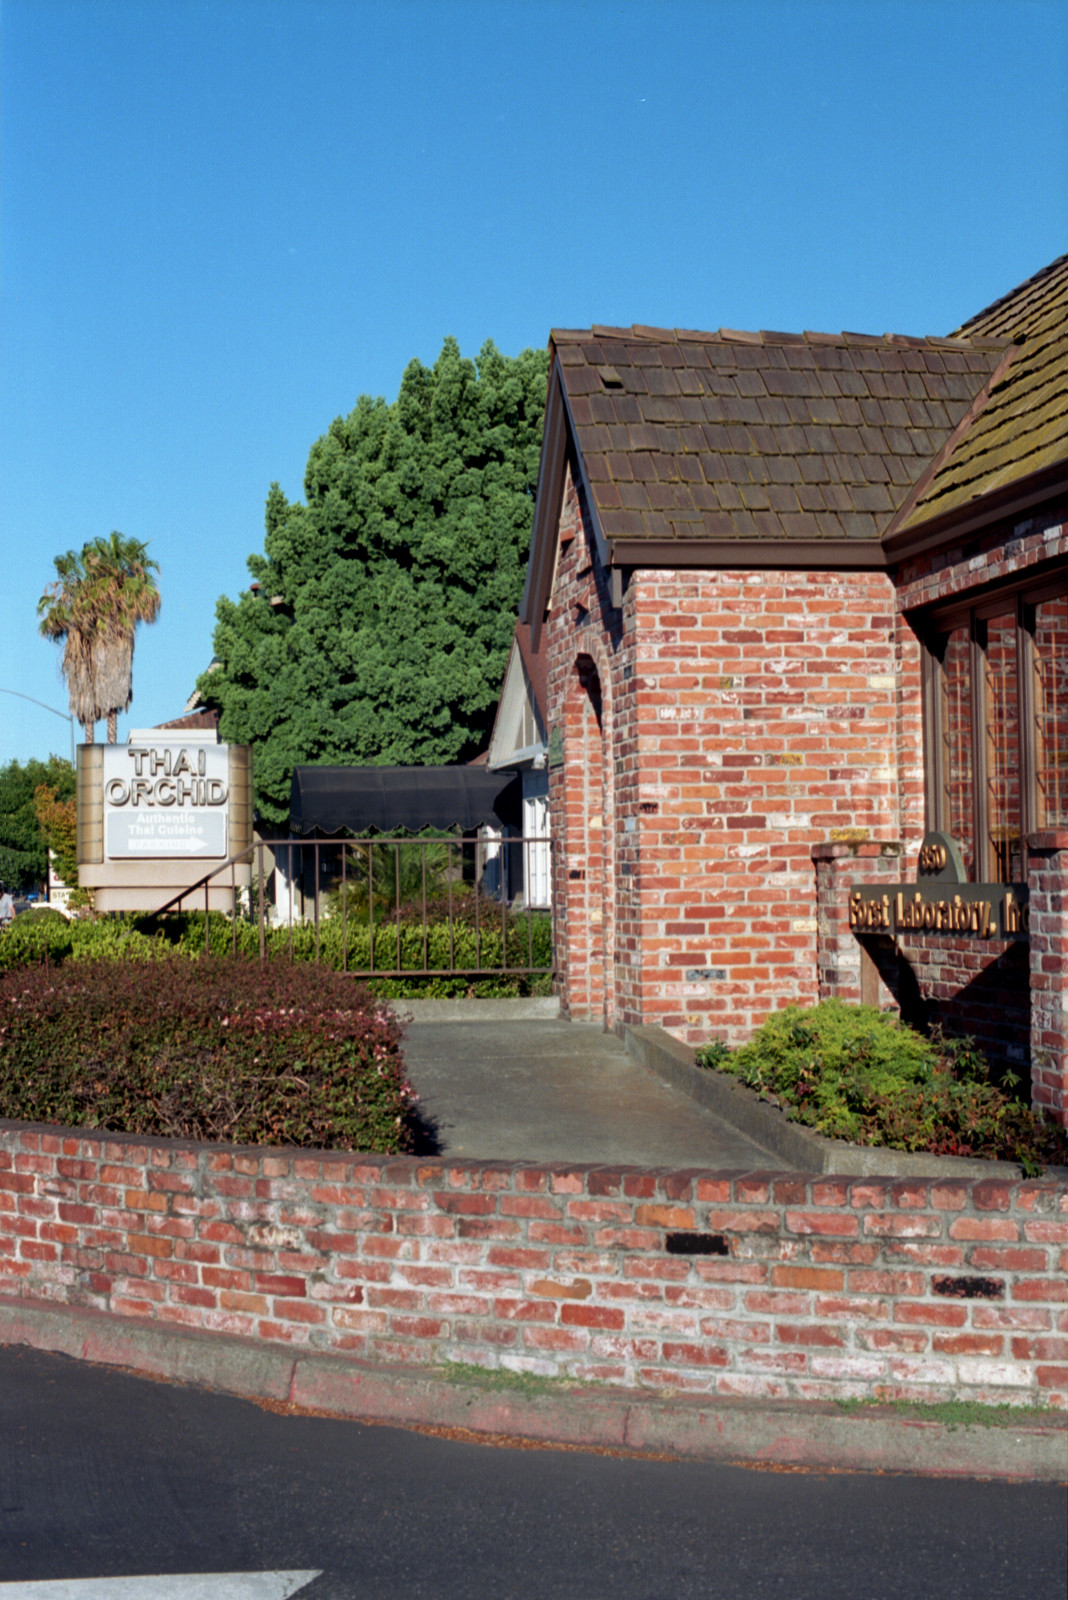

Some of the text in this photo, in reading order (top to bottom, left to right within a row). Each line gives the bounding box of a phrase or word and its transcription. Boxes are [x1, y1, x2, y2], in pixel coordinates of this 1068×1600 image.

[128, 748, 206, 777] THAI
[105, 778, 229, 807] ORCHID
[128, 825, 203, 835] Thai Cuisine
[136, 813, 195, 824] Authentic
[921, 844, 947, 870] 850
[849, 891, 890, 927] Forst
[895, 891, 997, 939] Laboratory,
